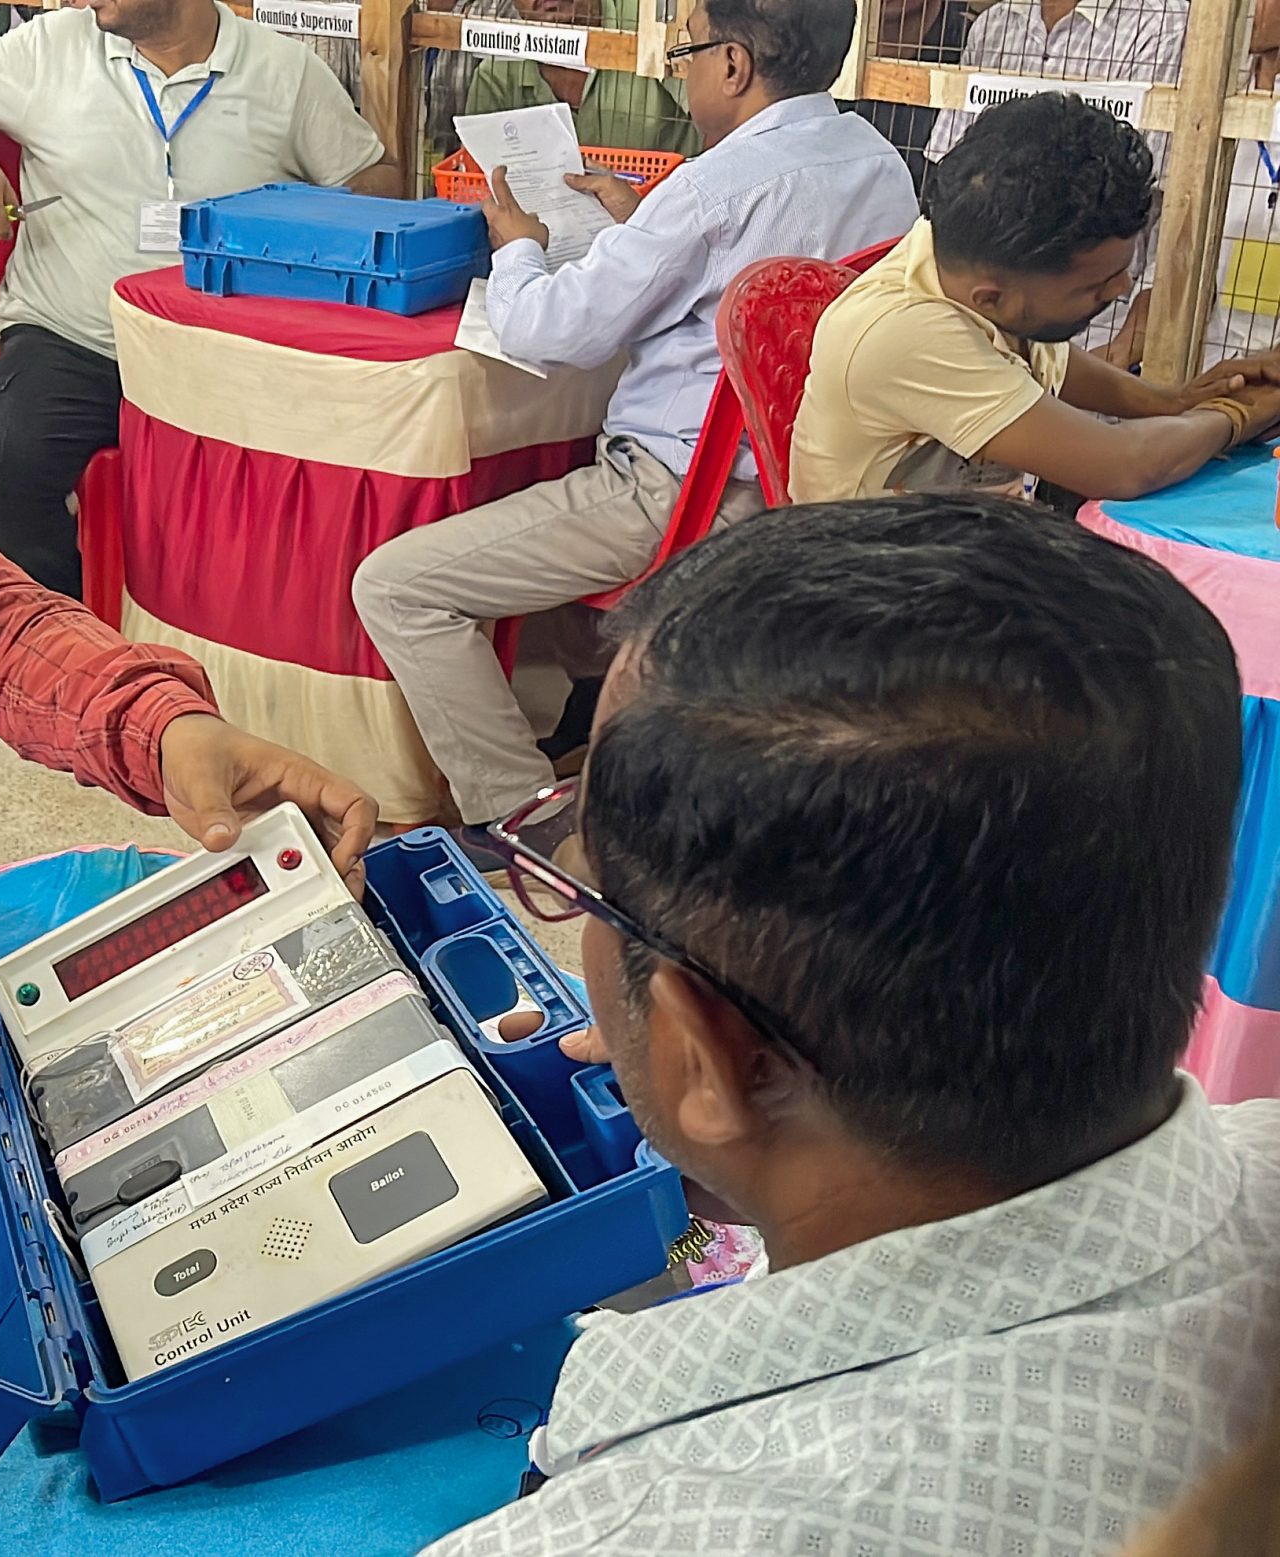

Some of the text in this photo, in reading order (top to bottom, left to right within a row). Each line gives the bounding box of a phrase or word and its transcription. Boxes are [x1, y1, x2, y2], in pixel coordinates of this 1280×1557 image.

[255, 7, 354, 33] Counting Supervisor
[466, 28, 581, 56] Counting Assistant
[335, 1101, 350, 1113] DC
[189, 1211, 217, 1231] मध्य
[220, 1192, 250, 1217] प्रदेश
[253, 1174, 283, 1197] राज्य
[283, 1149, 333, 1181] निर्वाचन
[336, 1125, 377, 1153] आयोग
[370, 1167, 406, 1192] Ballot
[669, 1221, 713, 1263] ngel
[173, 1262, 200, 1283] Total
[154, 1327, 214, 1366] Control
[217, 1309, 252, 1333] Unit
